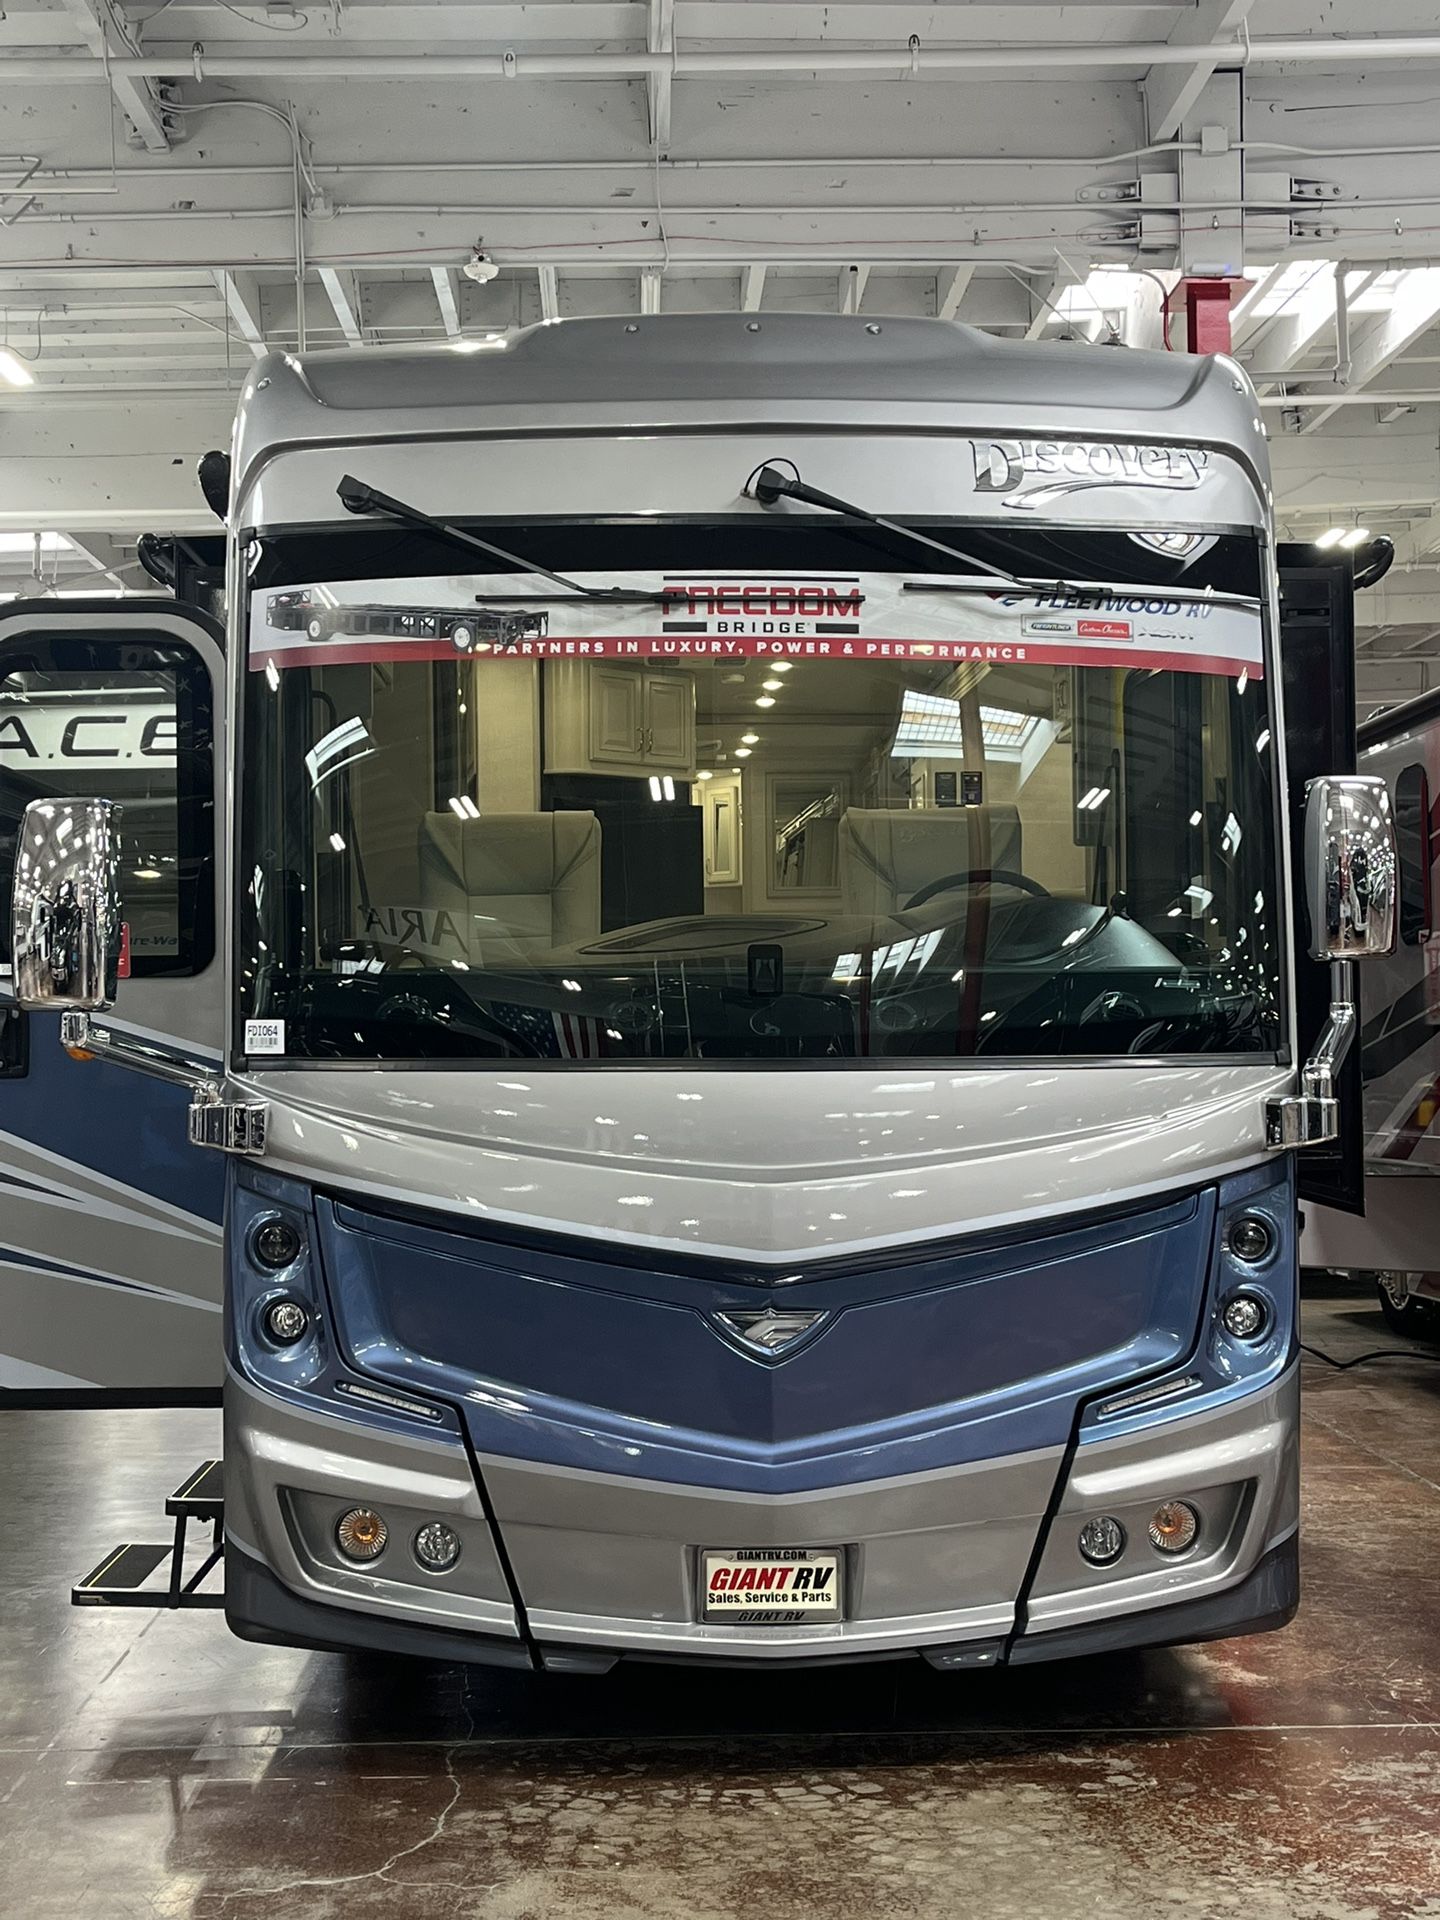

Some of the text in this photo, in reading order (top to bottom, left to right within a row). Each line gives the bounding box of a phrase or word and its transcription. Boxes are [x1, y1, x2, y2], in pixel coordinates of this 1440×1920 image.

[968, 439, 1208, 492] Discovery
[662, 587, 860, 616] FREEDOM
[1034, 592, 1213, 619] FLEETWOOD RV
[717, 622, 806, 634] BRIDGE
[493, 641, 1026, 660] PARTNERS IN LUXURY, POWER & PERFORMANCE
[736, 1550, 808, 1561] GIANTRV.COM
[709, 1567, 834, 1591] GIANT RV
[708, 1591, 832, 1605] Sales, Service & Parts
[738, 1611, 805, 1622] GIANT RV
